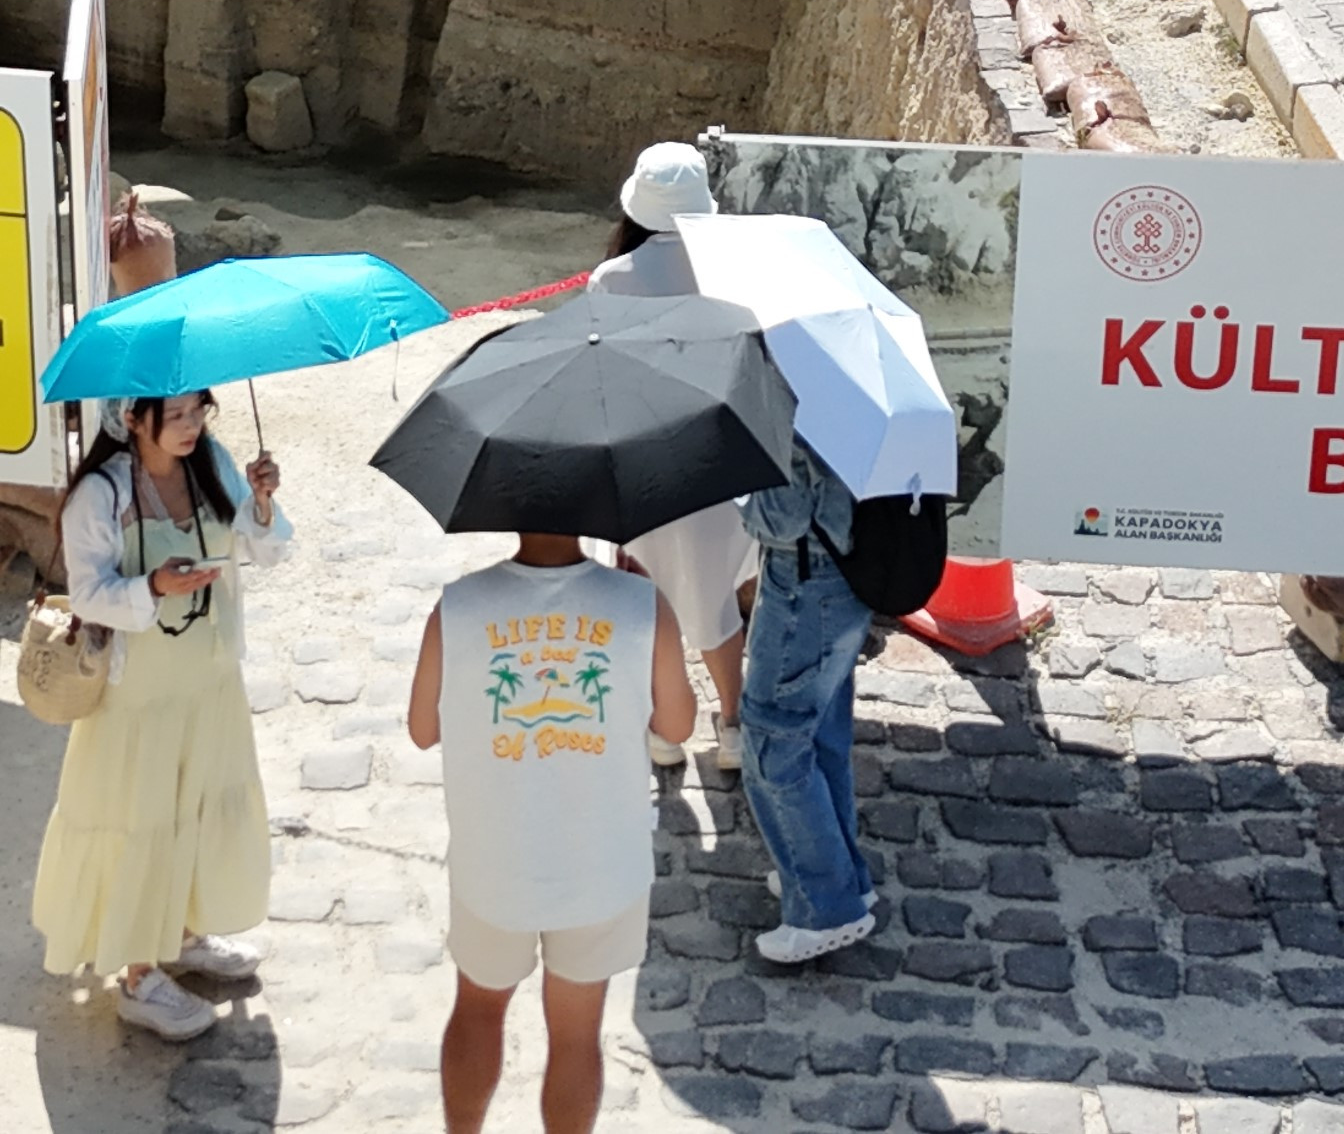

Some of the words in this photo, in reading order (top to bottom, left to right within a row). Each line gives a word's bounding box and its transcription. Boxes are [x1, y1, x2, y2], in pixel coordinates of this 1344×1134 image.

[1114, 515, 1223, 533] KAPADOKYA
[1114, 528, 1148, 540] ALAN
[1149, 530, 1223, 544] BAŞKANLIĞI
[485, 615, 566, 649] LIFE
[574, 616, 614, 646] IS
